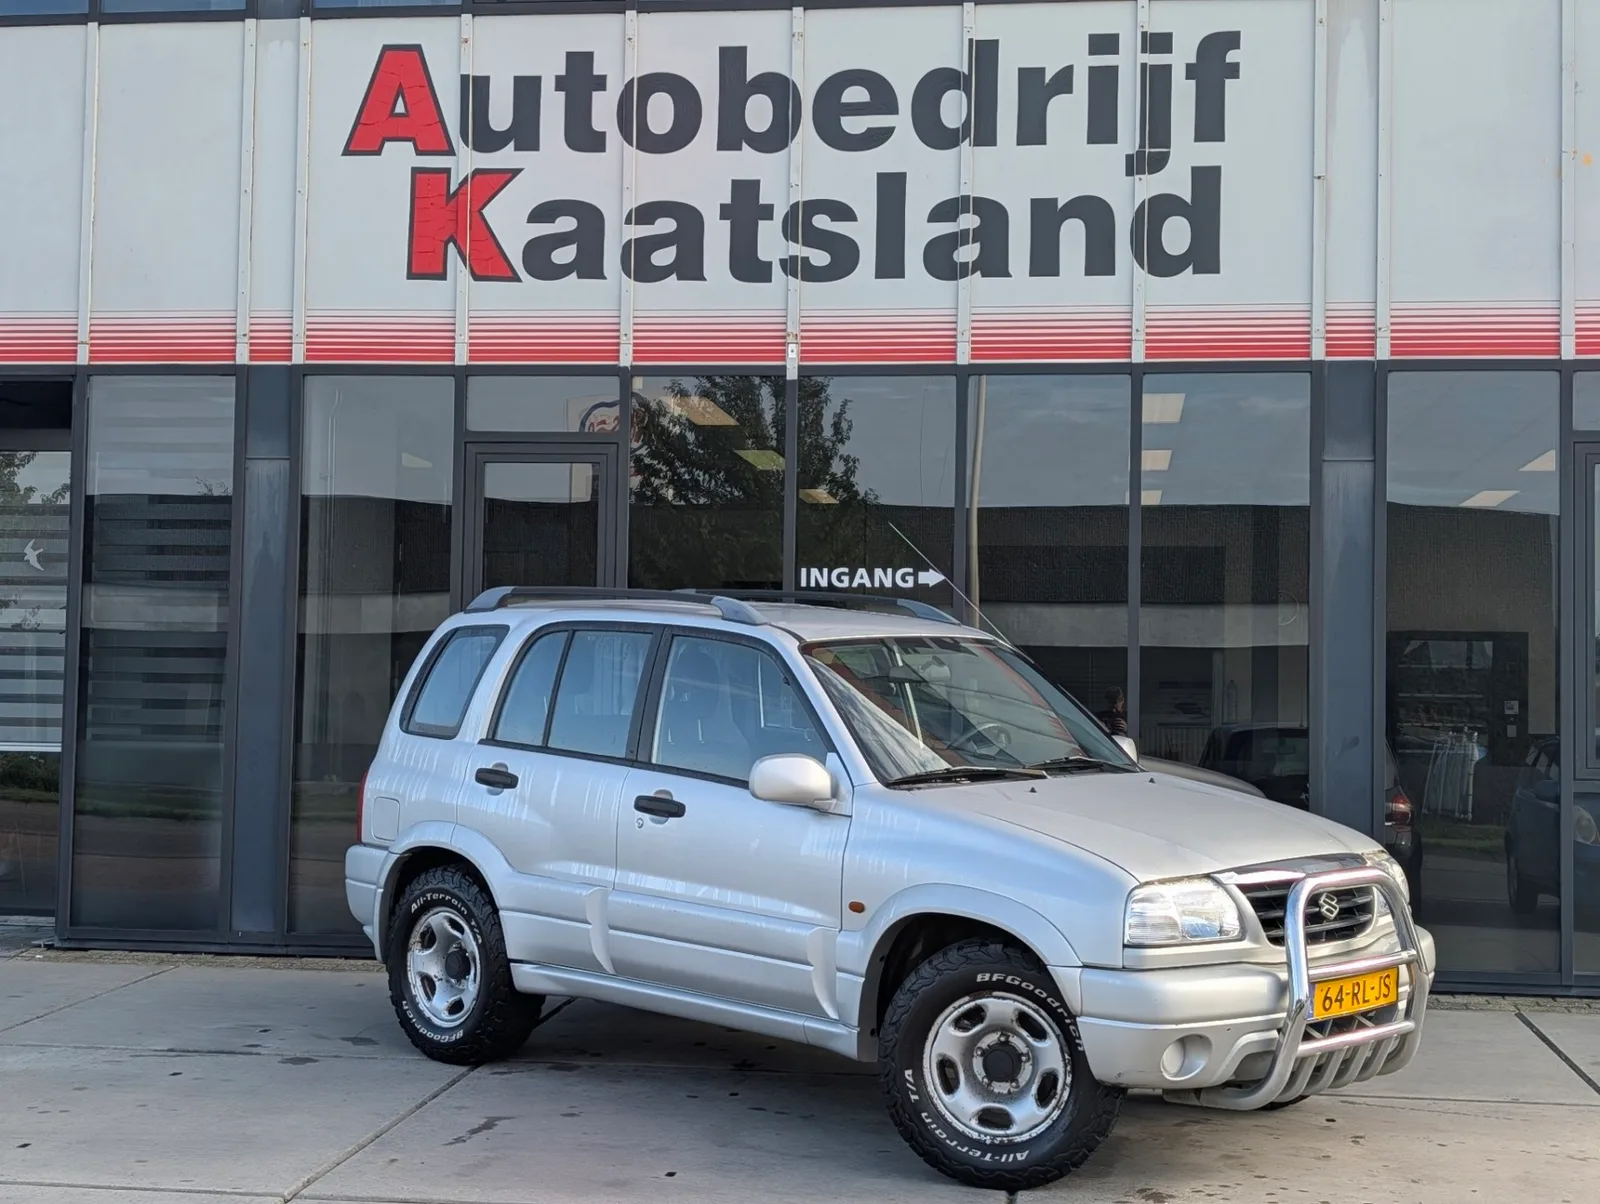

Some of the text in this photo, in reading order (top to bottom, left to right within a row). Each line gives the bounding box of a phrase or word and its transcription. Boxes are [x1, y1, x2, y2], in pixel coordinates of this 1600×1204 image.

[341, 30, 1241, 177] Autobedrijf
[406, 165, 1222, 283] Kaatsland
[800, 567, 915, 588] INGANG
[410, 892, 468, 915] All-Terrain
[1322, 973, 1392, 1012] 64-RL-JS
[402, 1000, 464, 1043] BFGoodrich
[904, 1068, 920, 1103] T/A
[921, 1111, 1030, 1163] All-Terrain
